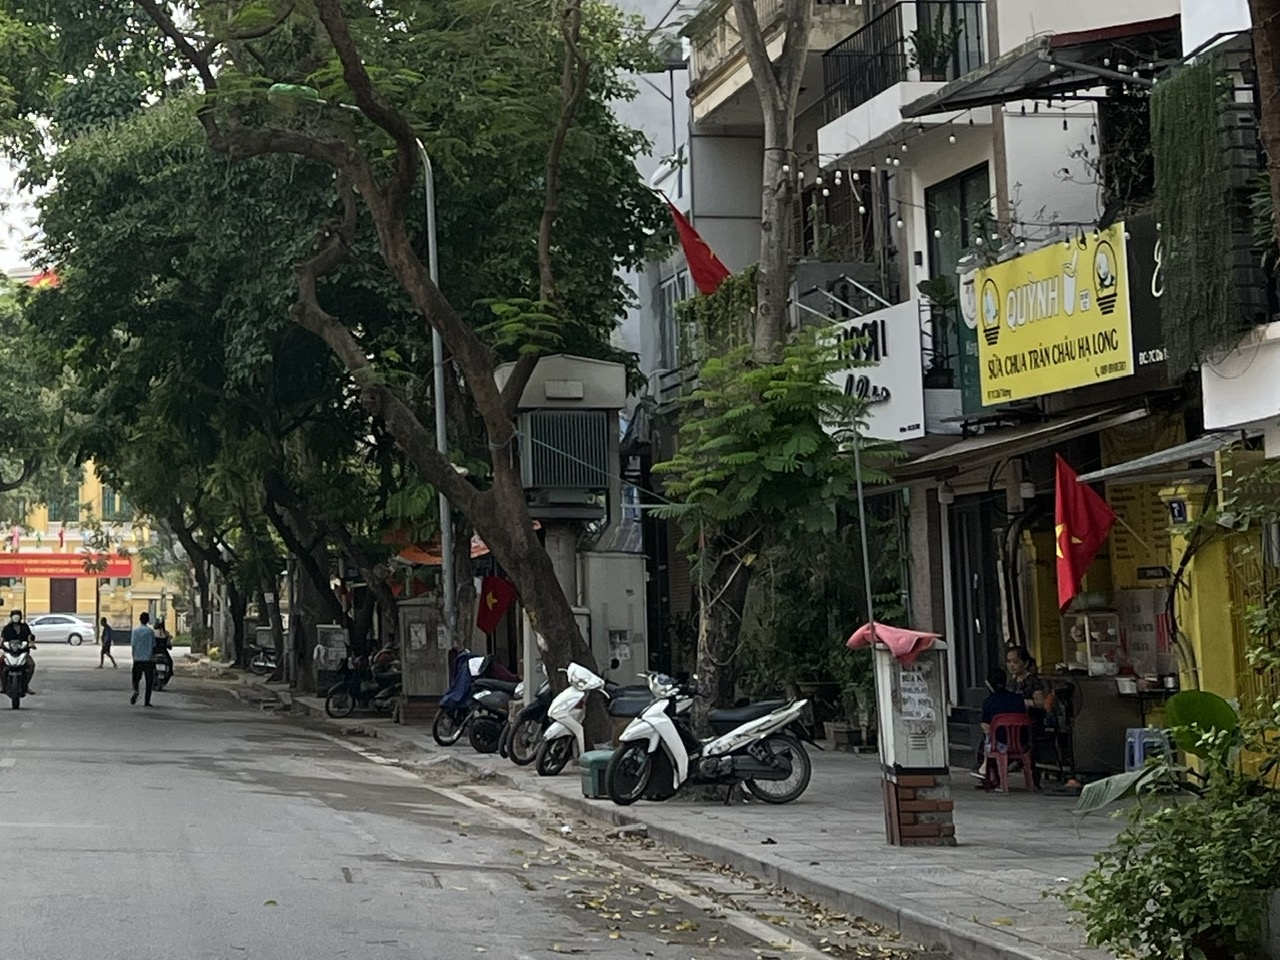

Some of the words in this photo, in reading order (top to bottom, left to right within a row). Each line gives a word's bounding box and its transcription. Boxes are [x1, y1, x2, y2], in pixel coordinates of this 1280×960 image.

[1005, 350, 1027, 378] CHUA
[1052, 336, 1076, 365] CHÂU
[1078, 336, 1091, 362] HẠ
[1092, 329, 1118, 356] LONG
